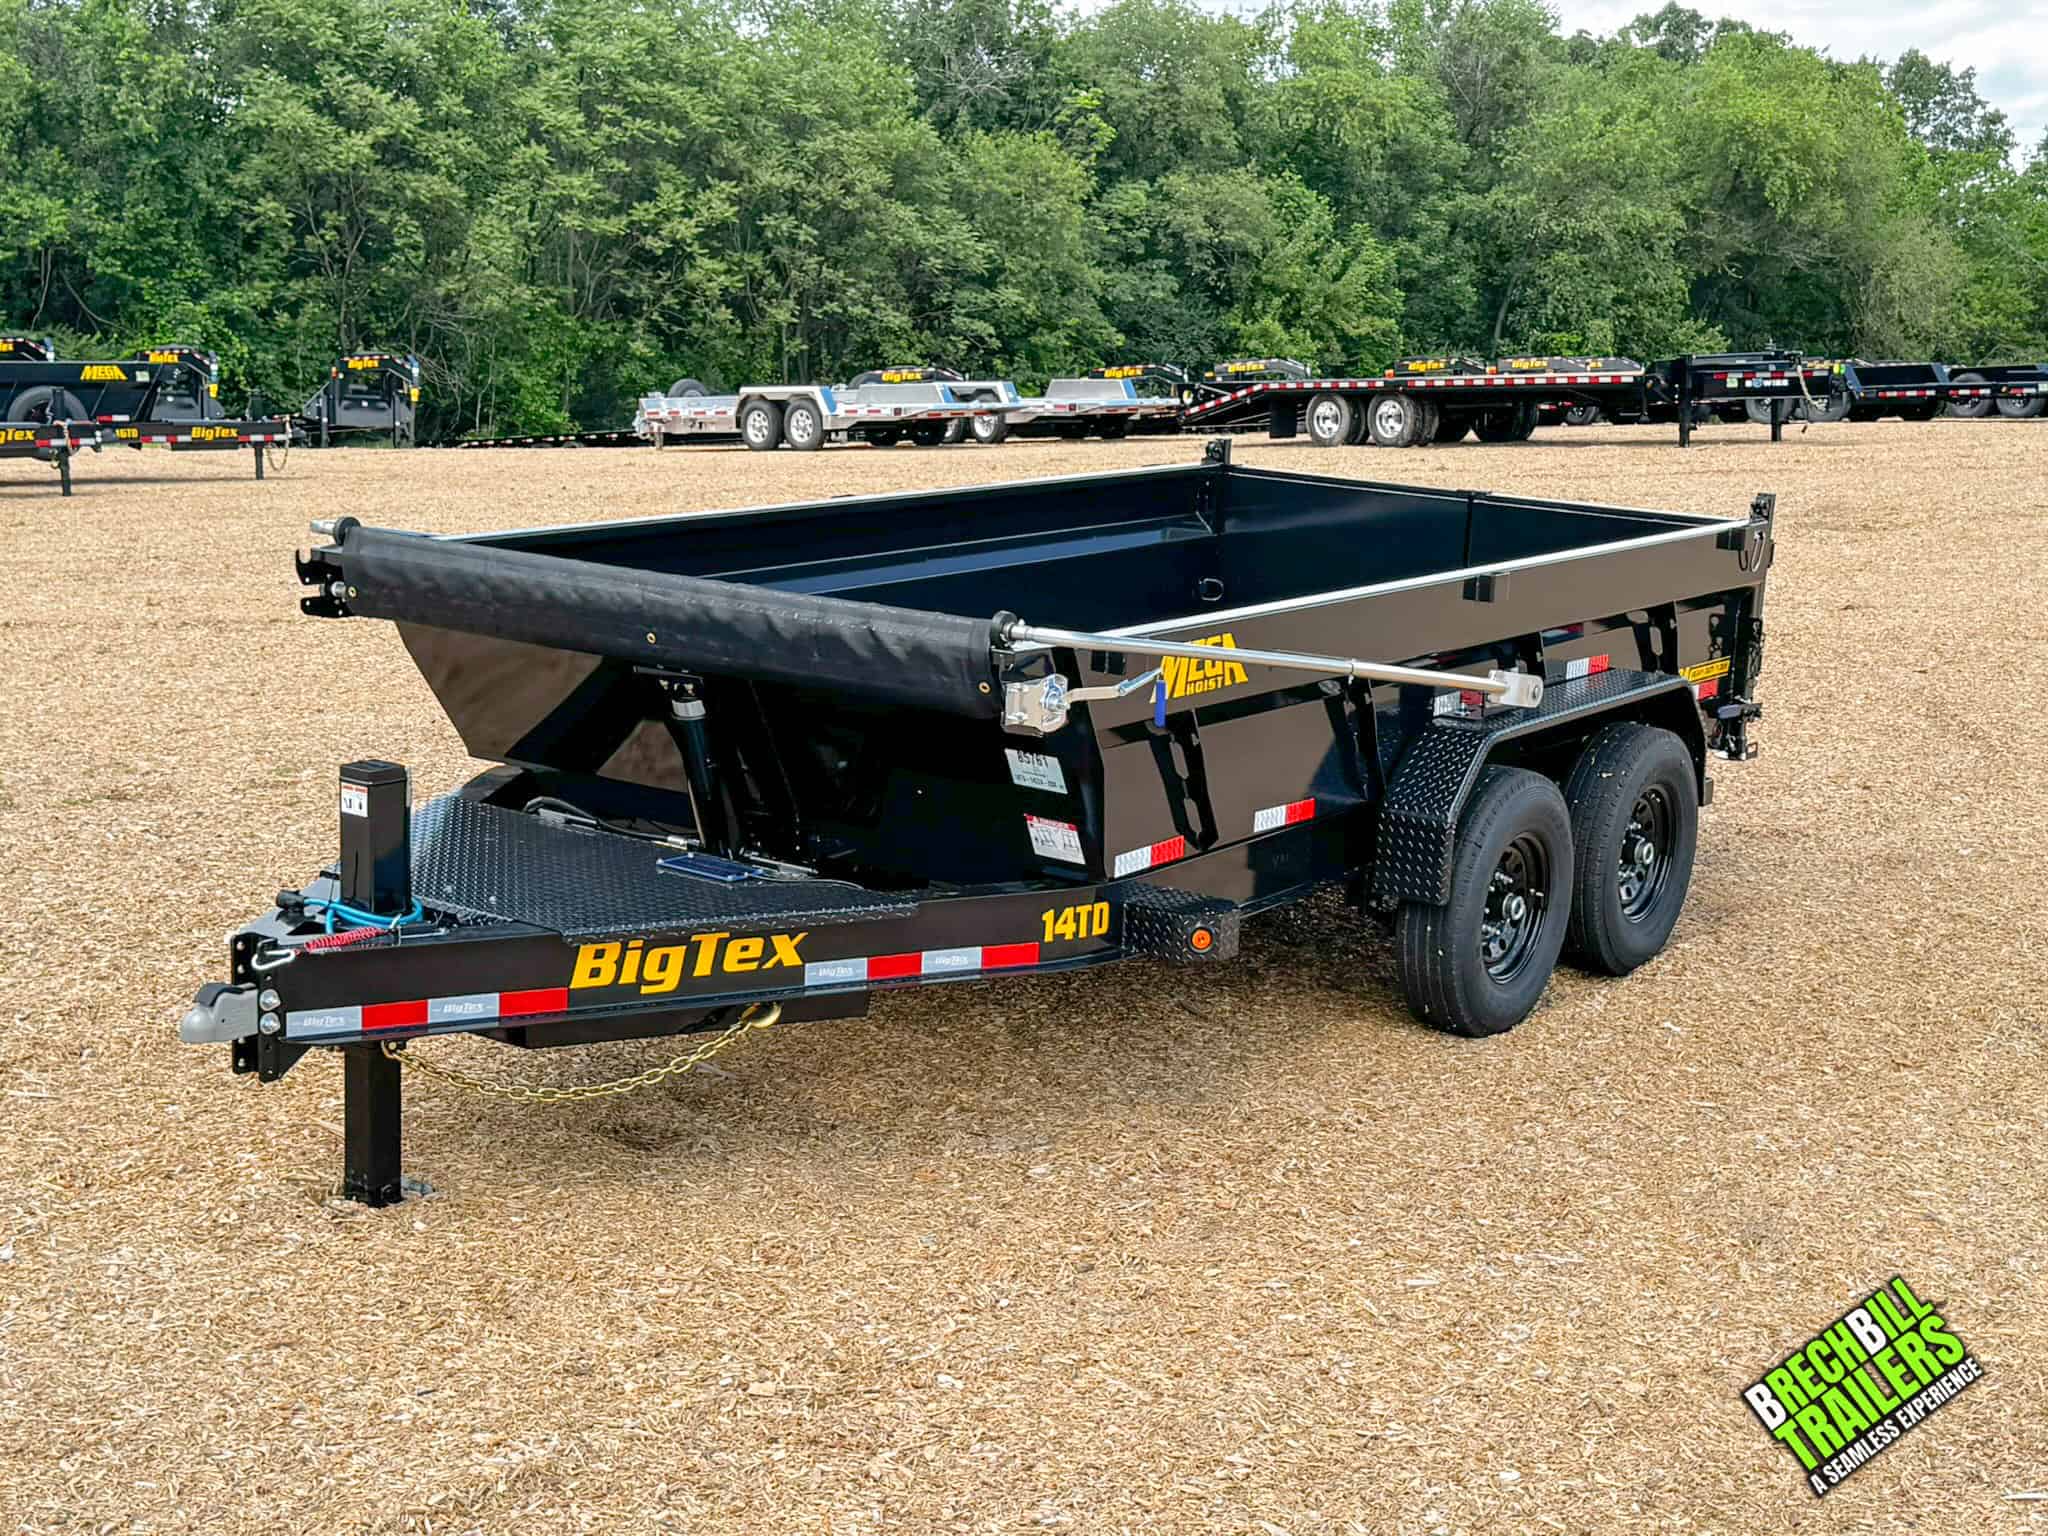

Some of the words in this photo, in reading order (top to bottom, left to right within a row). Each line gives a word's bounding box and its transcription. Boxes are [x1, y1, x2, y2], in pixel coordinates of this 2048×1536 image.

[80, 365, 128, 380] MEGA
[881, 371, 922, 383] BigTex
[191, 426, 238, 441] BigTex
[1186, 676, 1224, 696] HOIST
[1041, 901, 1110, 943] 14TD
[569, 931, 809, 995] BigTex
